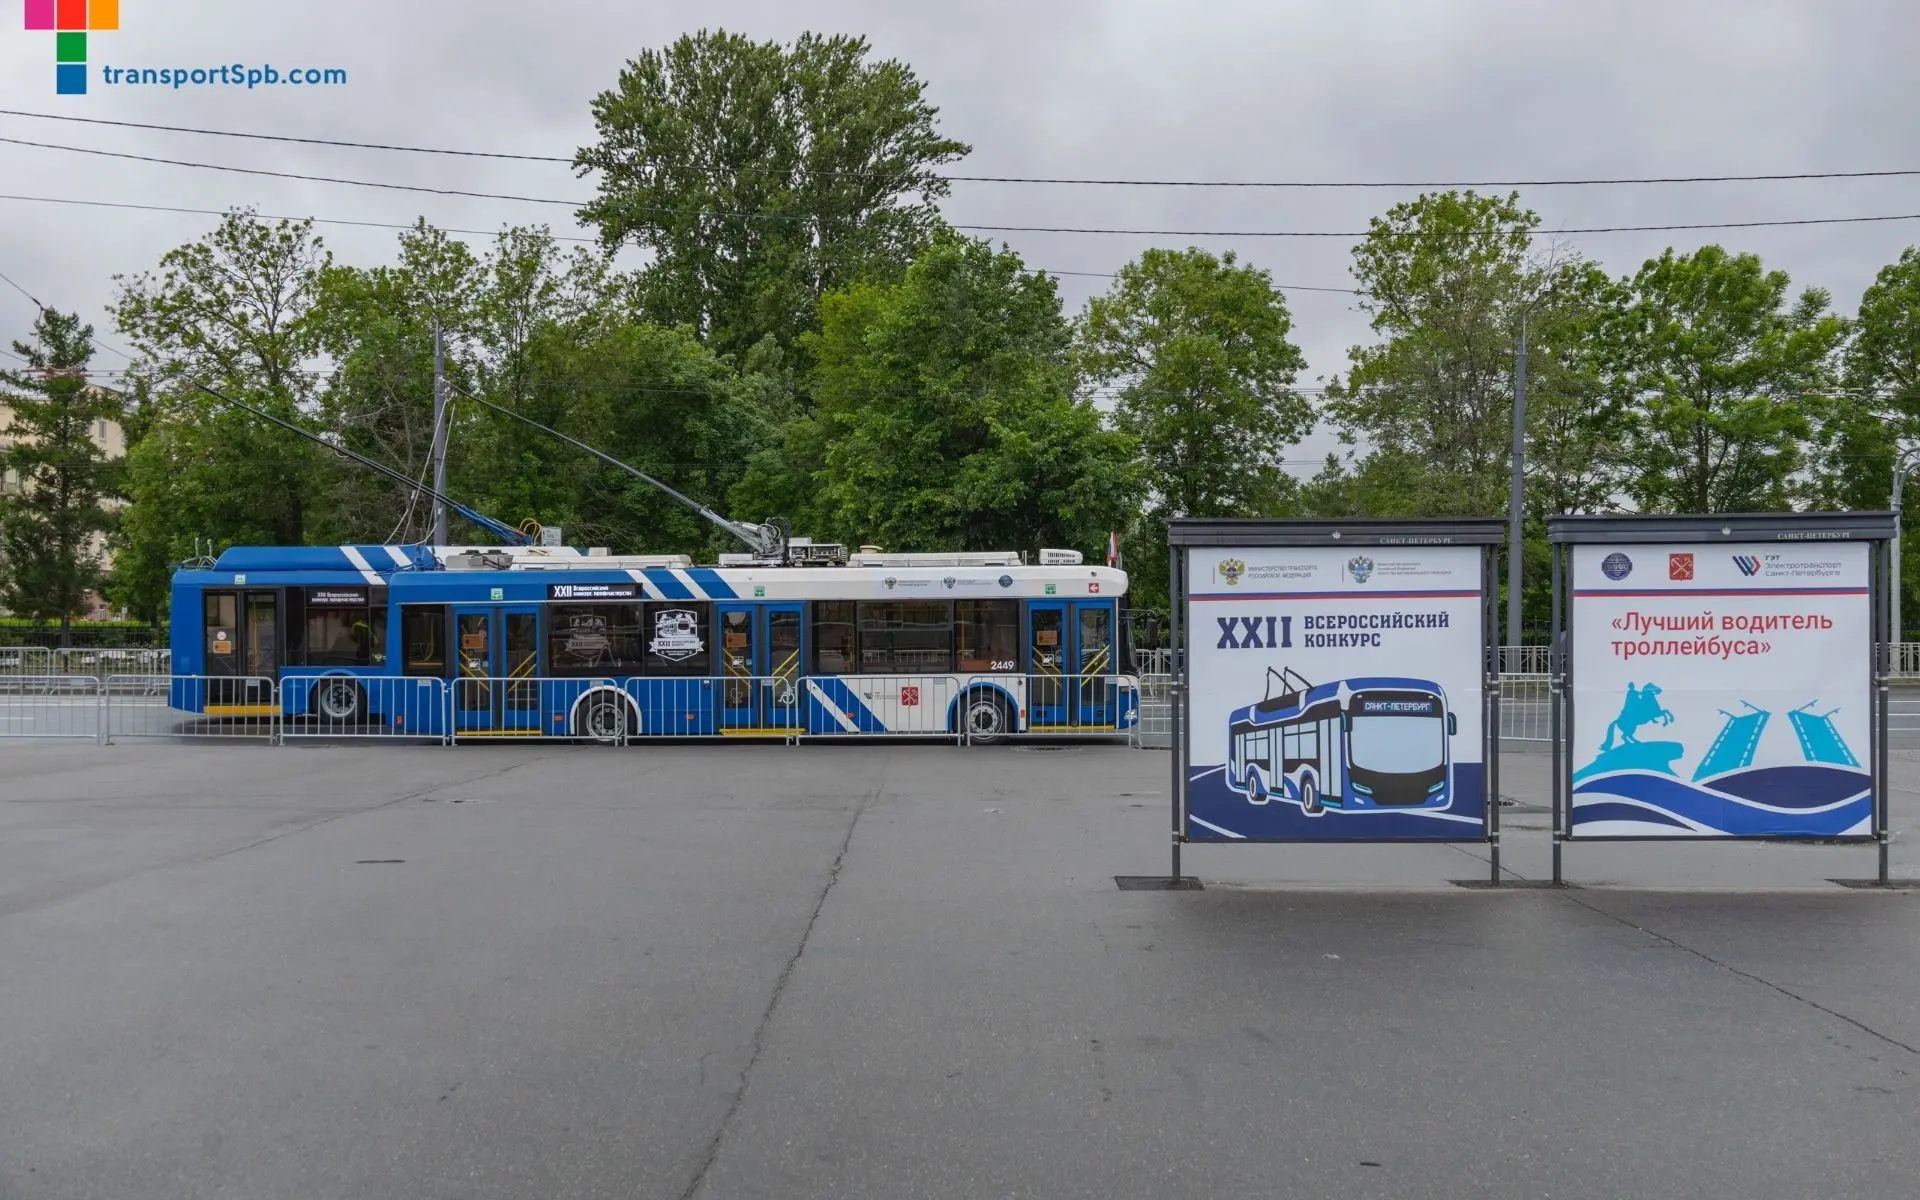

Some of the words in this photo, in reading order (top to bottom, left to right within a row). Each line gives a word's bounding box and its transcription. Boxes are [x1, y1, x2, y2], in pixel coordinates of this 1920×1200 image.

[1777, 532, 1850, 540] САНКТ-ПЕТЕРБУРГ
[1765, 561, 1842, 569] Электротранспорт
[553, 585, 572, 597] XXII
[1304, 611, 1450, 630] ВСЕРОССИЙСКИЙ
[1611, 610, 1714, 635] «Лучший
[1722, 612, 1833, 634] водитель
[1216, 616, 1292, 649] XXII
[1304, 632, 1381, 648] КОНКУРС
[1611, 636, 1771, 659] троллейбуса»
[990, 660, 1015, 670] 2449
[1364, 702, 1431, 712] САНКТ-ПЕТЕРБУРГ
